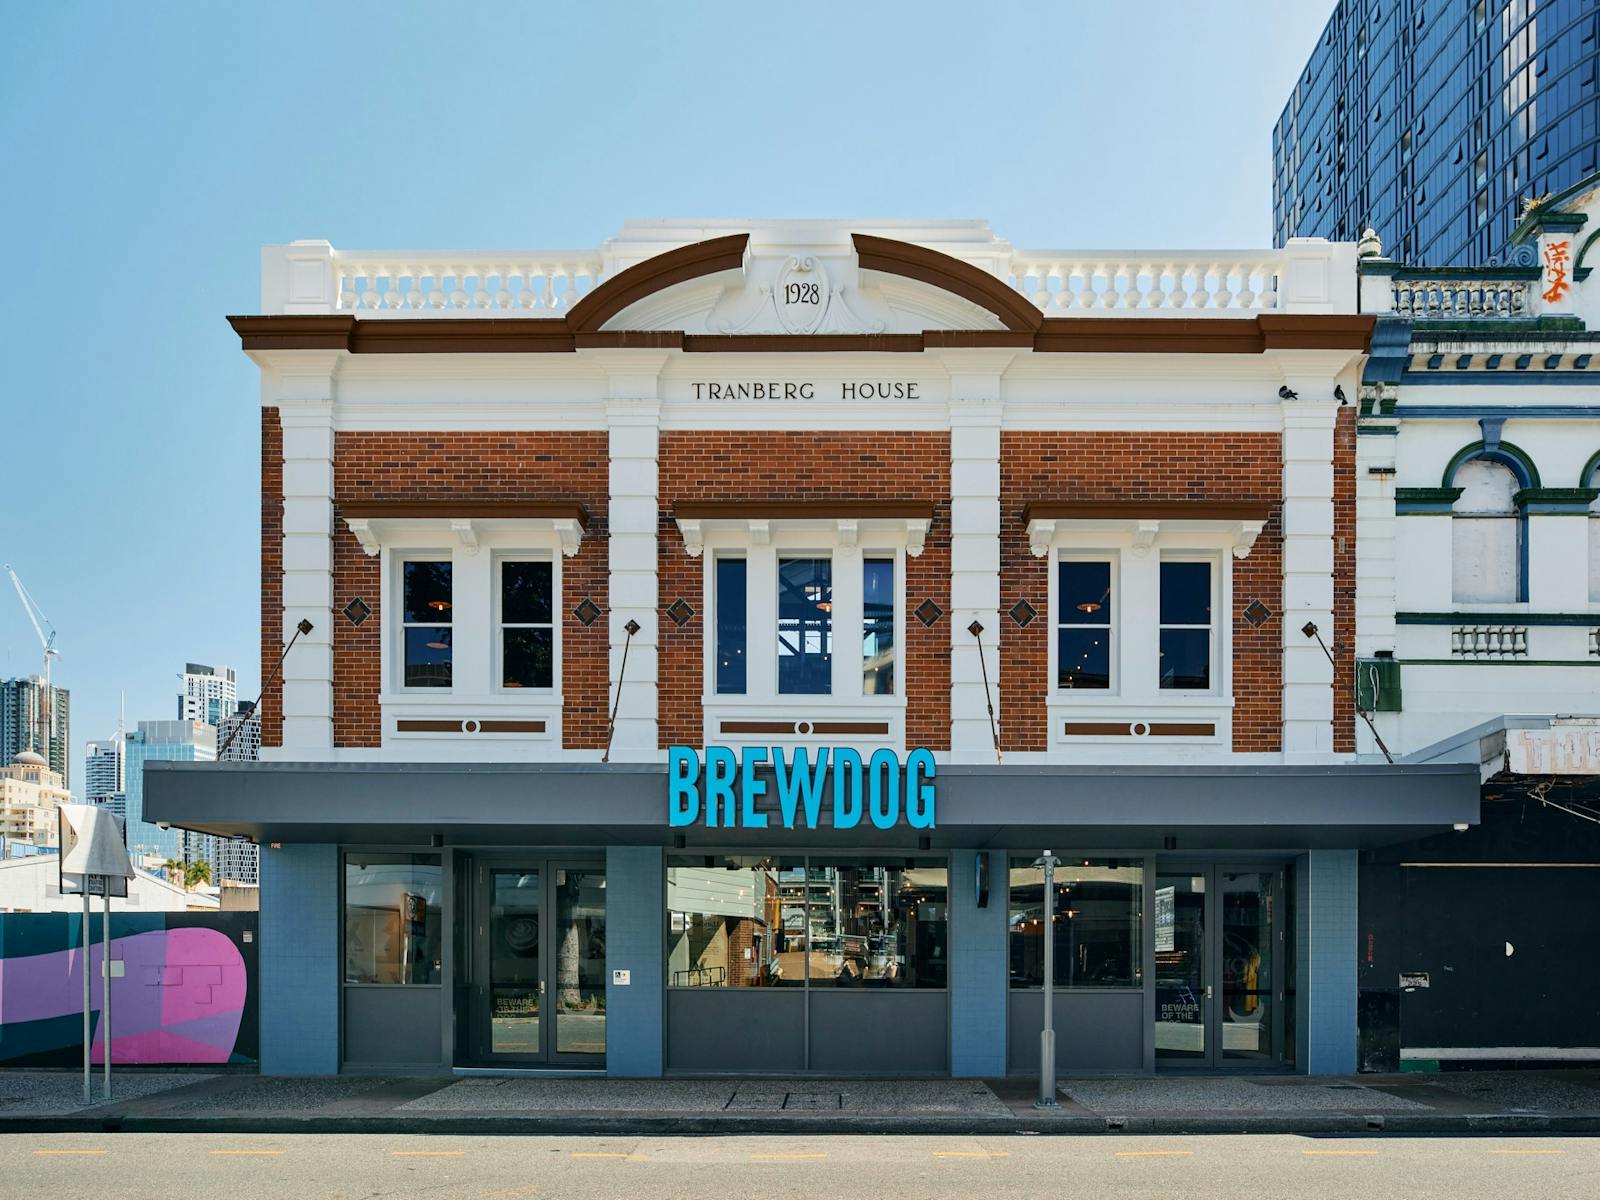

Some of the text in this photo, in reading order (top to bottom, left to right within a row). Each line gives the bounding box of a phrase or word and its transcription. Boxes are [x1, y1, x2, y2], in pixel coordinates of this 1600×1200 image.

[784, 282, 820, 305] 1928
[691, 382, 921, 400] TRANBERG HOUSE
[668, 745, 937, 830] BREWDOG
[497, 998, 534, 1006] BEWARE
[1161, 1003, 1200, 1012] BEWARE
[1161, 1011, 1194, 1020] OF THE
